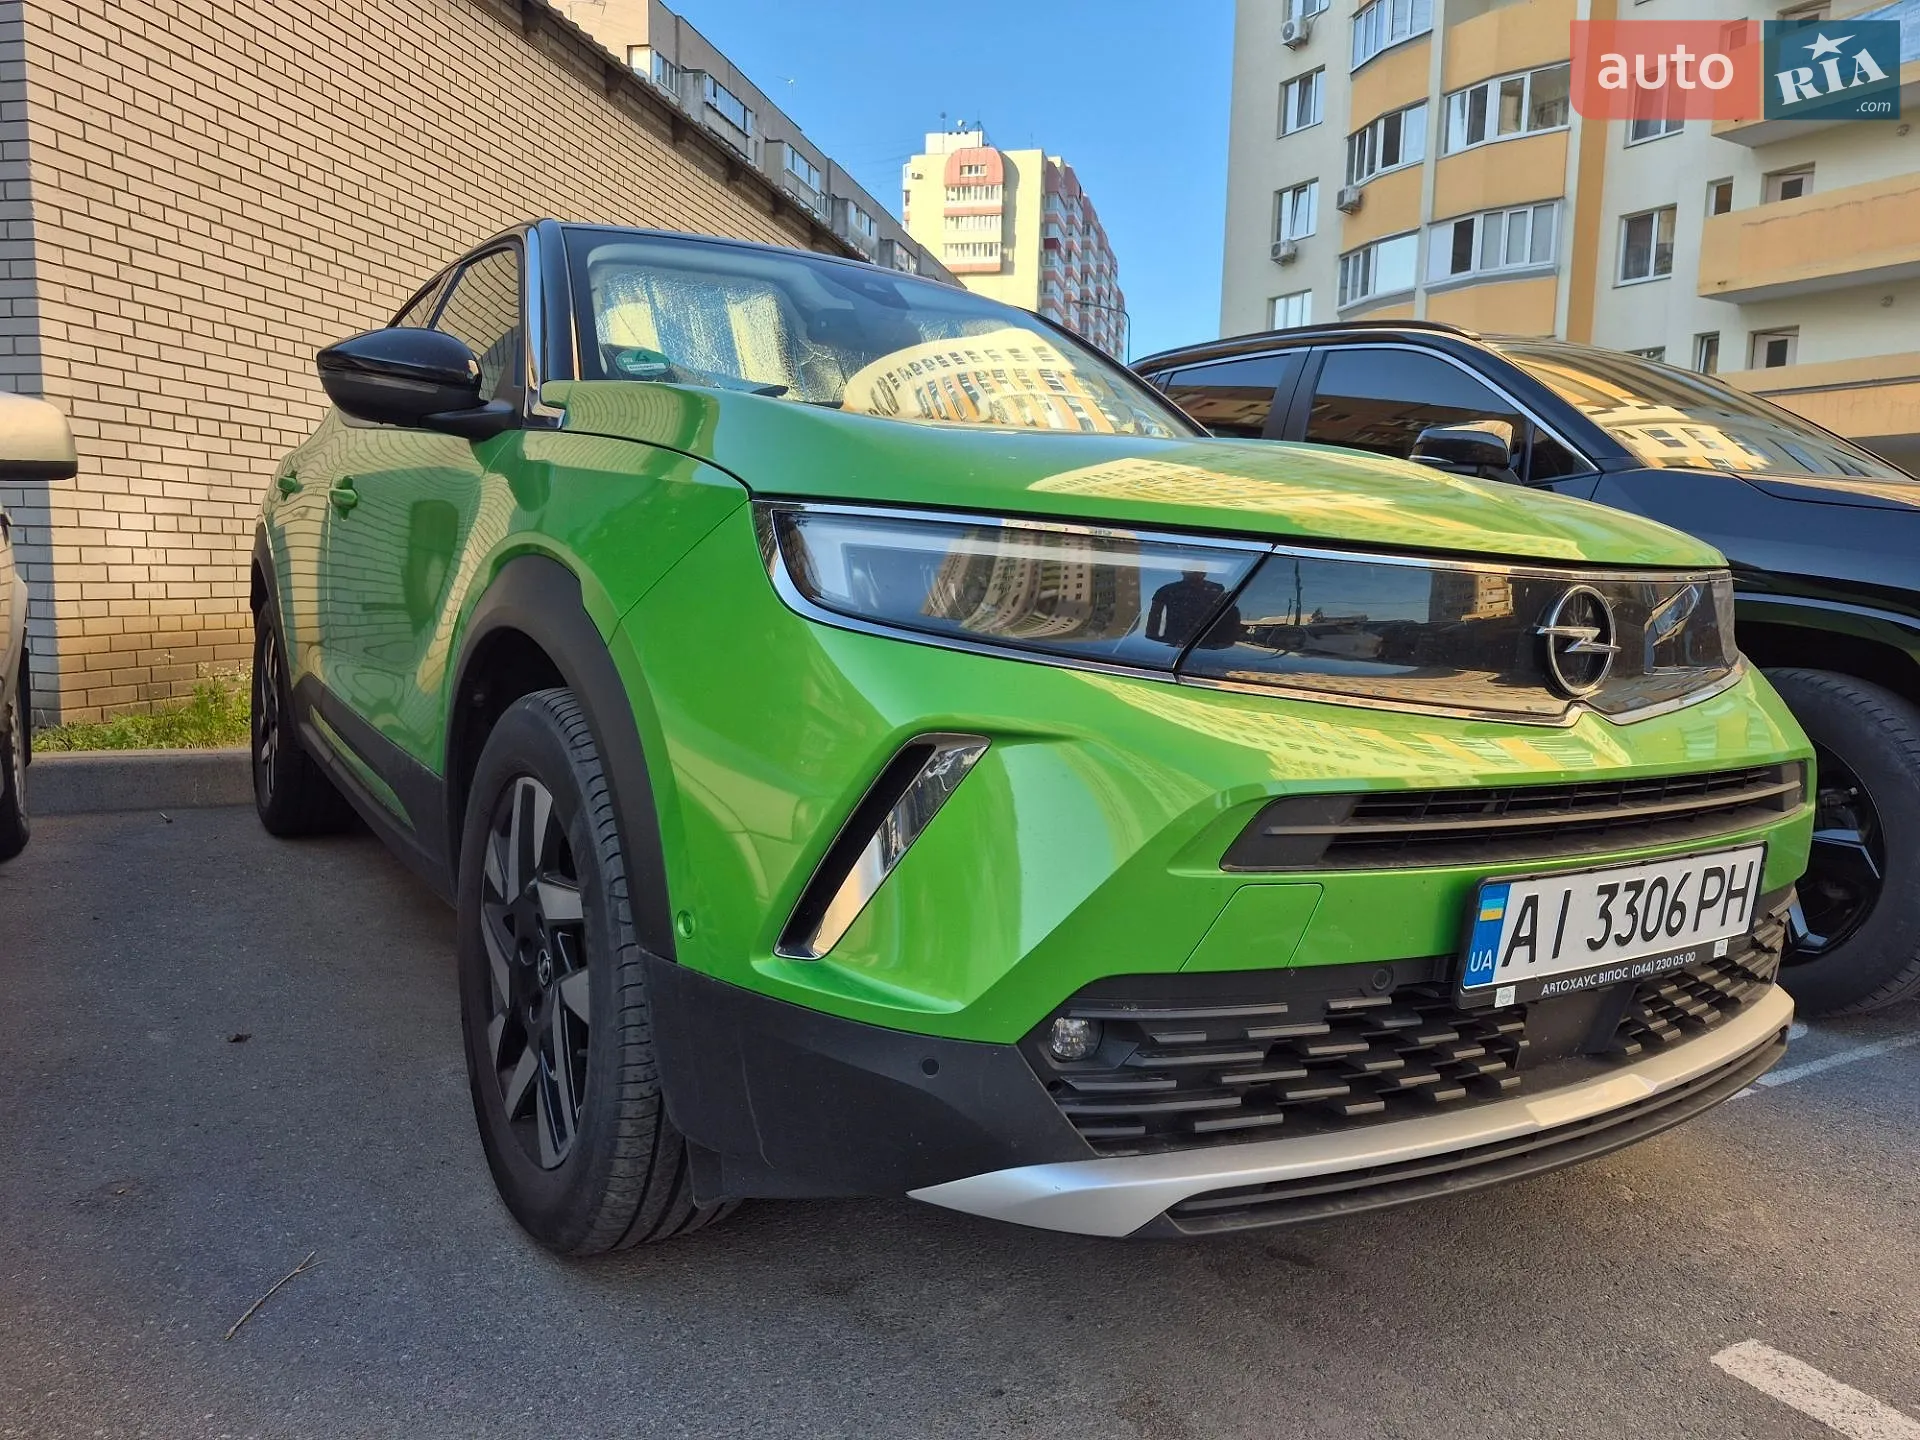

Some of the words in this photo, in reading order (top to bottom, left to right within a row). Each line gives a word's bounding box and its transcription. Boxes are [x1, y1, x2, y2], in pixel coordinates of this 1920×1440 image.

[1470, 951, 1493, 972] UA
[1541, 973, 1597, 996] АВТОХАУС
[1631, 960, 1654, 978] (044)
[1656, 956, 1672, 970] 230
[1673, 953, 1684, 966] 05
[1685, 951, 1697, 962] 00
